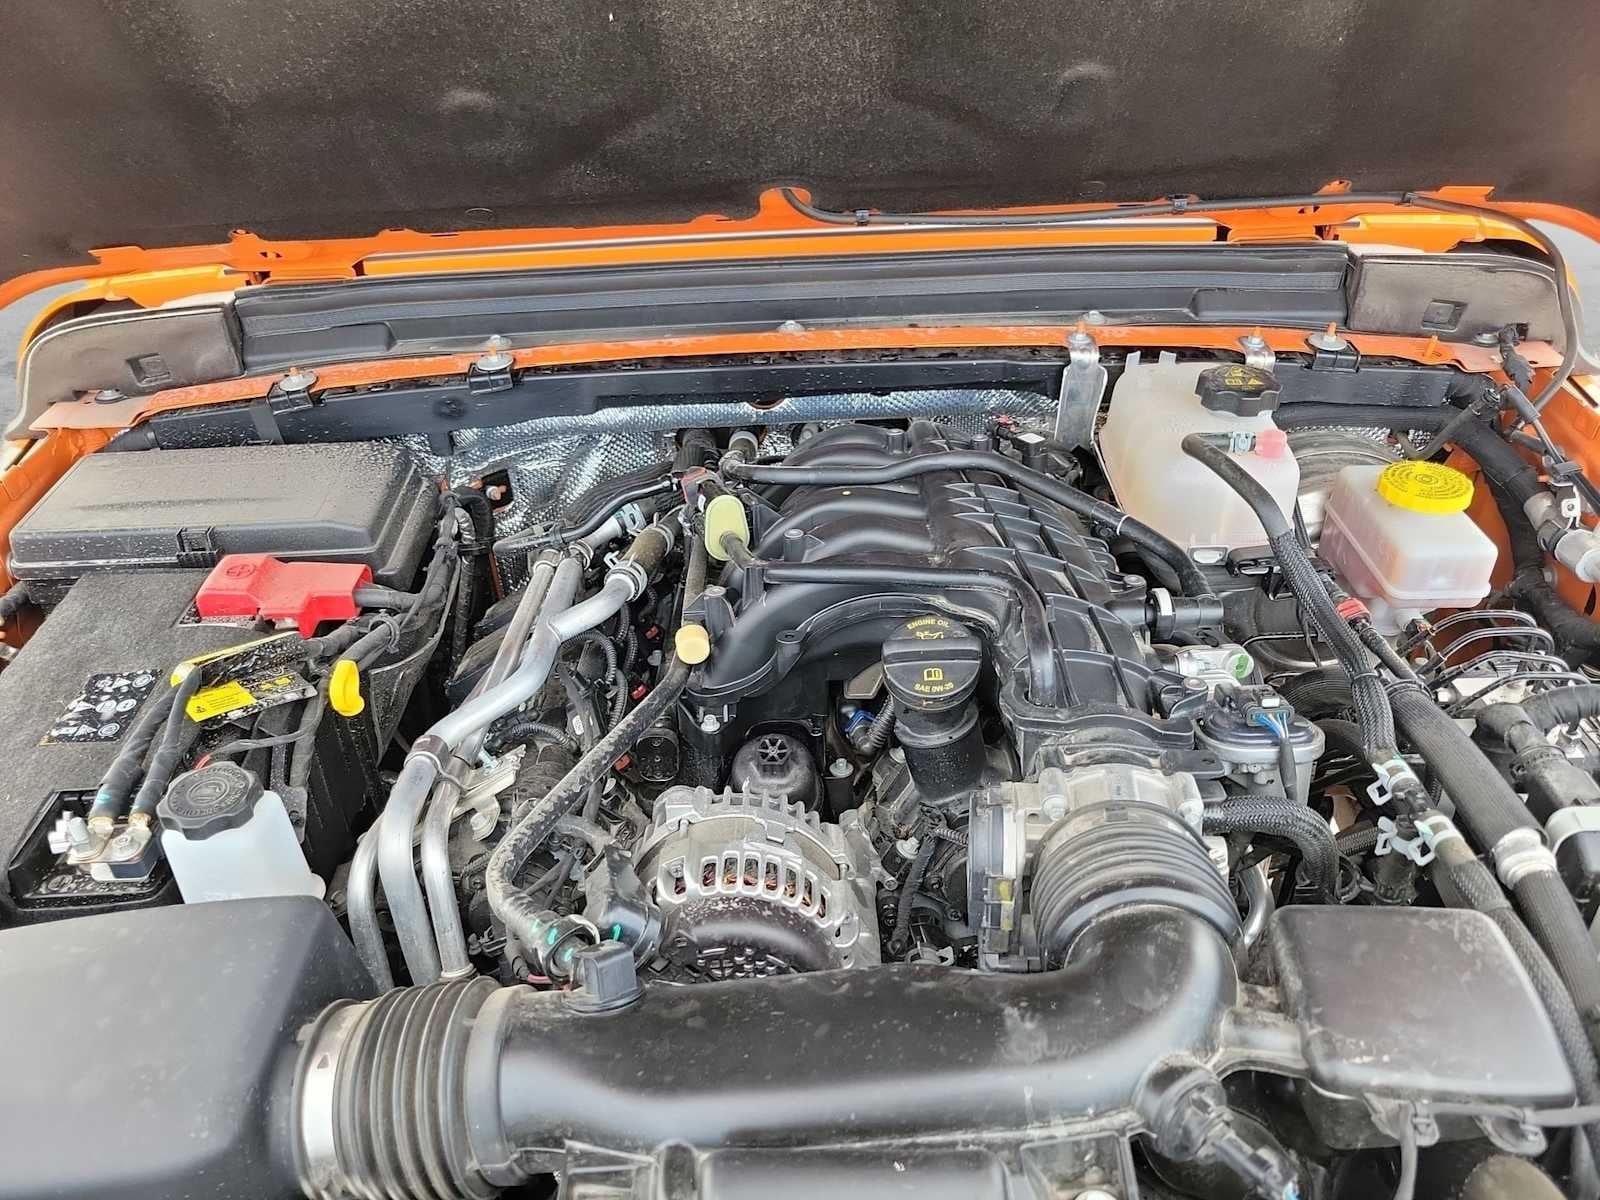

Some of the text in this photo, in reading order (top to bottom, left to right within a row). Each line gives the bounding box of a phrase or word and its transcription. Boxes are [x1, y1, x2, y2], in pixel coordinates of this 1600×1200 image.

[907, 618, 950, 630] ENGINE OIL
[913, 682, 930, 692] SAE
